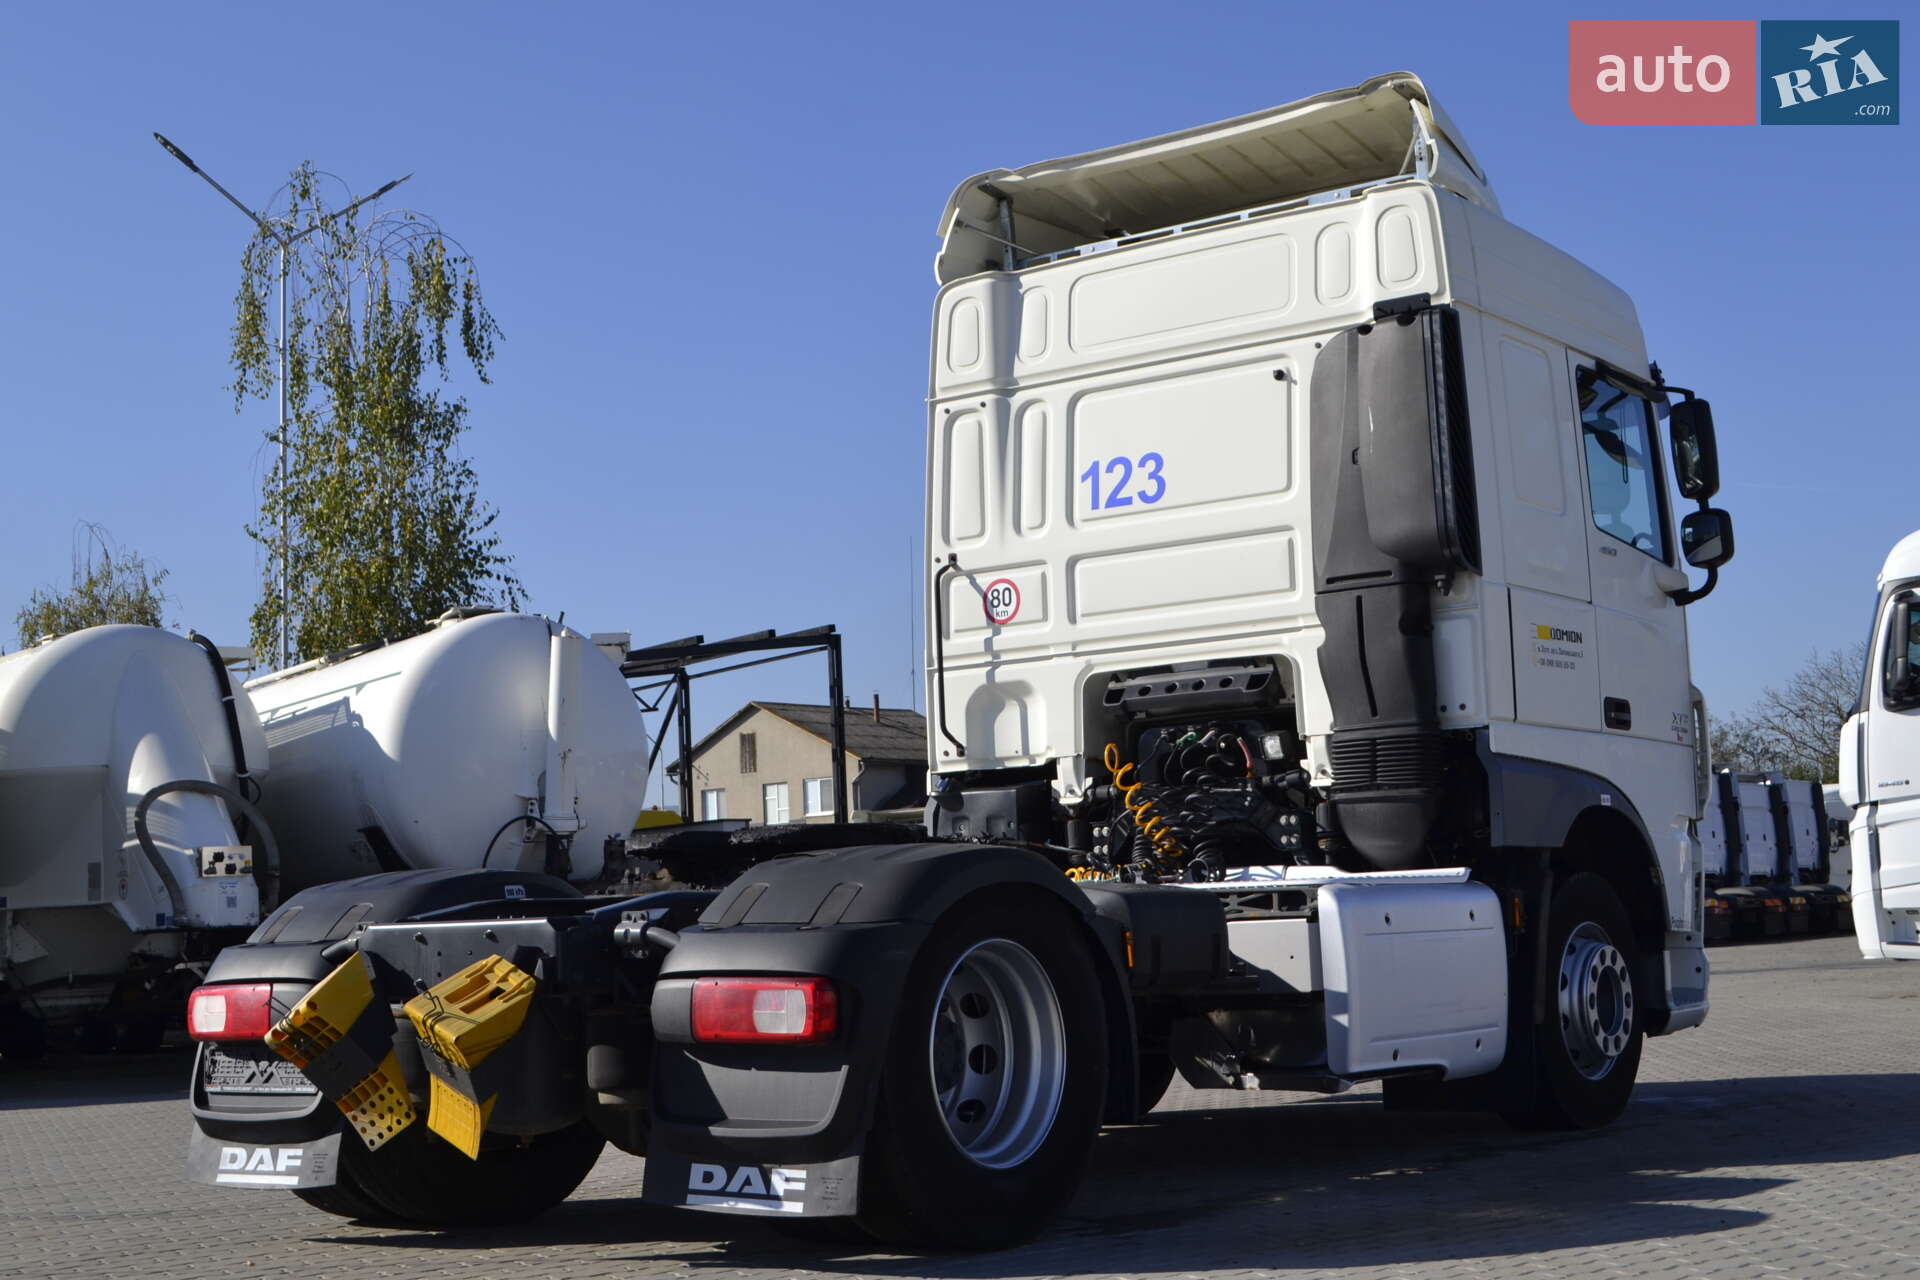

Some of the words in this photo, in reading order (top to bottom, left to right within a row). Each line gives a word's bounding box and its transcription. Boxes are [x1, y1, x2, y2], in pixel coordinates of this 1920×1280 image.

[1081, 452, 1166, 510] 123
[991, 587, 1012, 608] 80
[995, 608, 1009, 618] km
[218, 1147, 304, 1172] DAF
[688, 1163, 807, 1197] DAF
